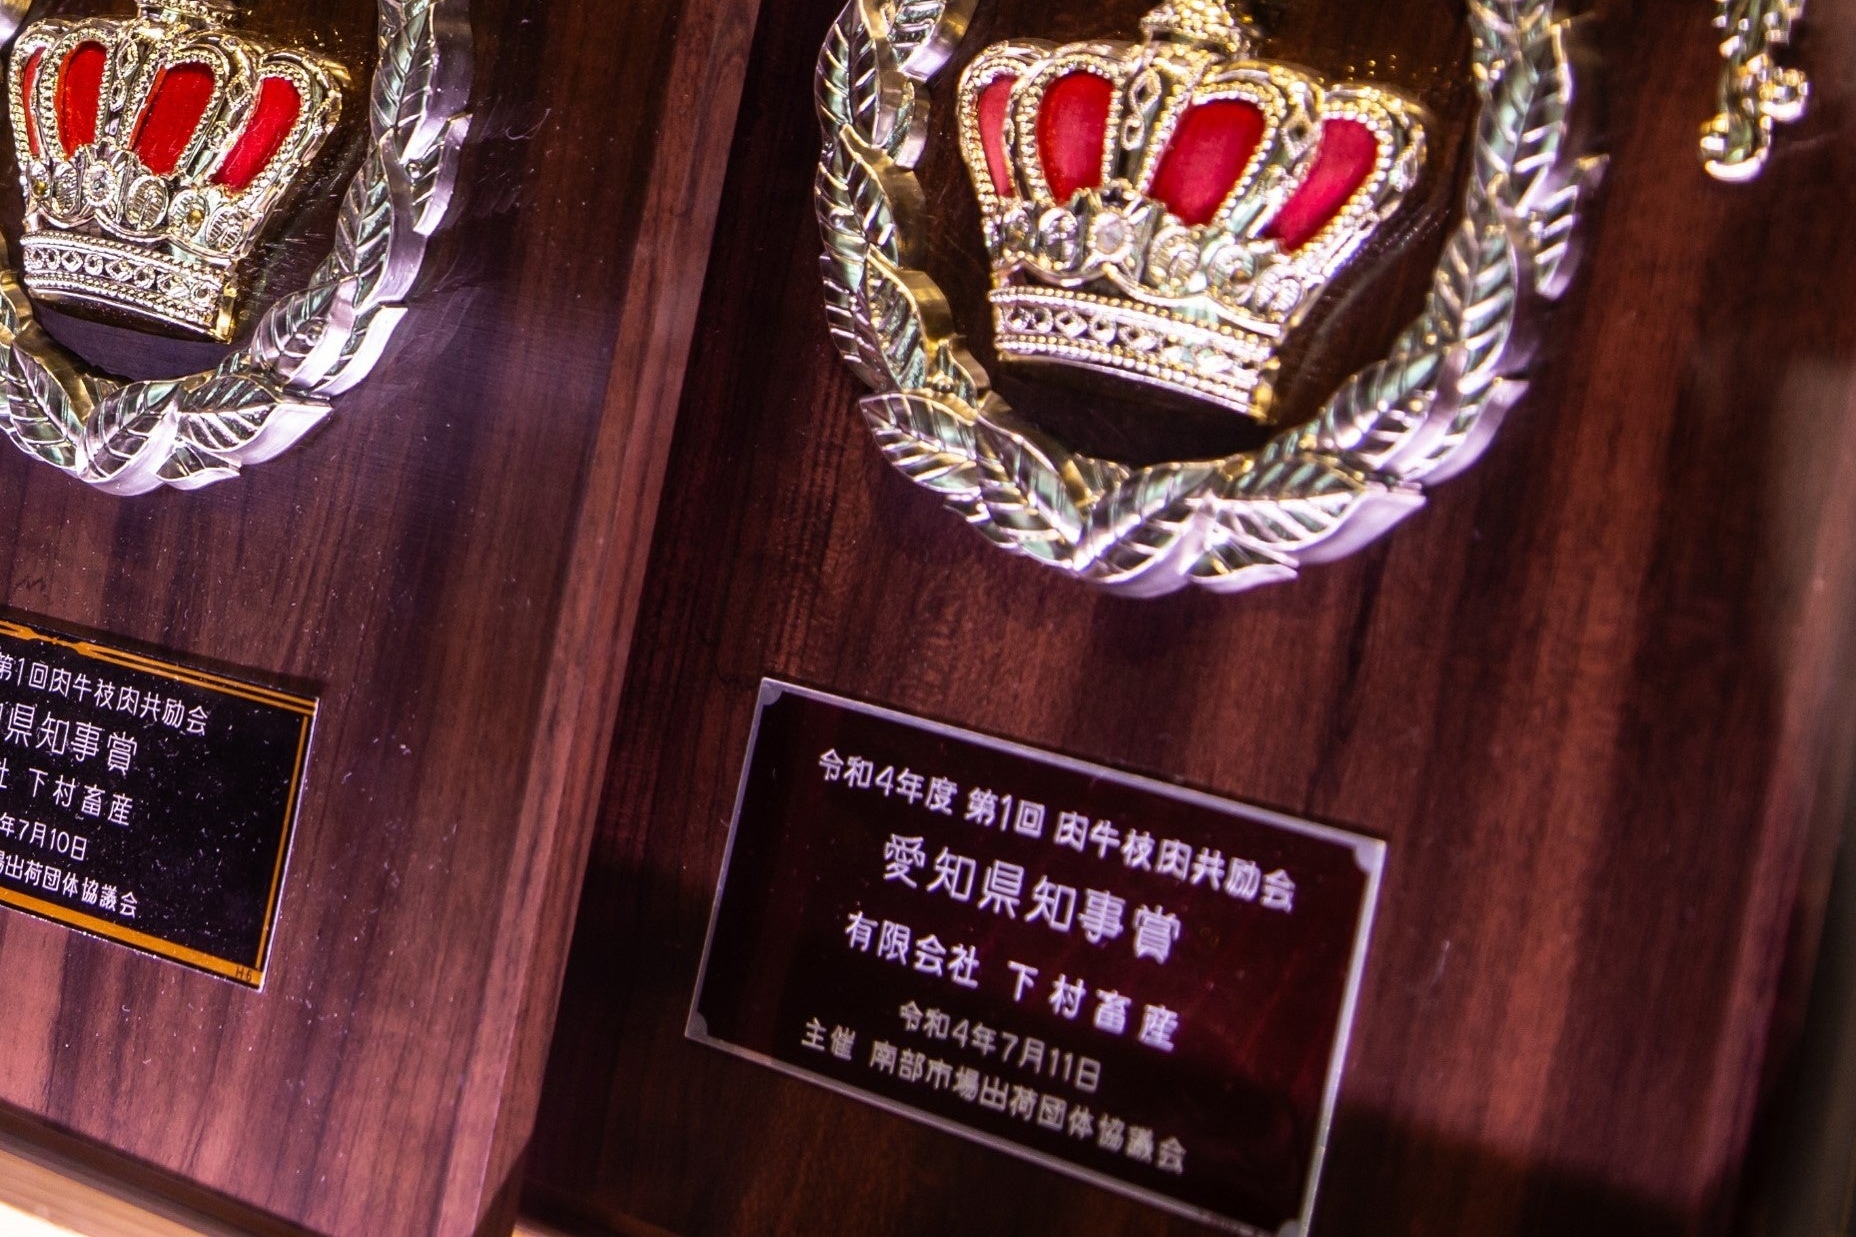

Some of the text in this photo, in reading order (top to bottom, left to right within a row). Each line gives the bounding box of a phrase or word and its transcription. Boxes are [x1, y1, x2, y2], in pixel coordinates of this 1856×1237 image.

[29, 768, 133, 826] 下村畜産
[818, 748, 1296, 913] 令和4年度 第1回 肉牛枝肉共励会
[883, 833, 1182, 963] 愛知県知事賞
[844, 911, 1179, 1052] 有限会社 下村畜産
[898, 1000, 1101, 1093] 令和4年7月11日
[801, 1017, 1187, 1175] 主催 南部市場出荷団体協議会
